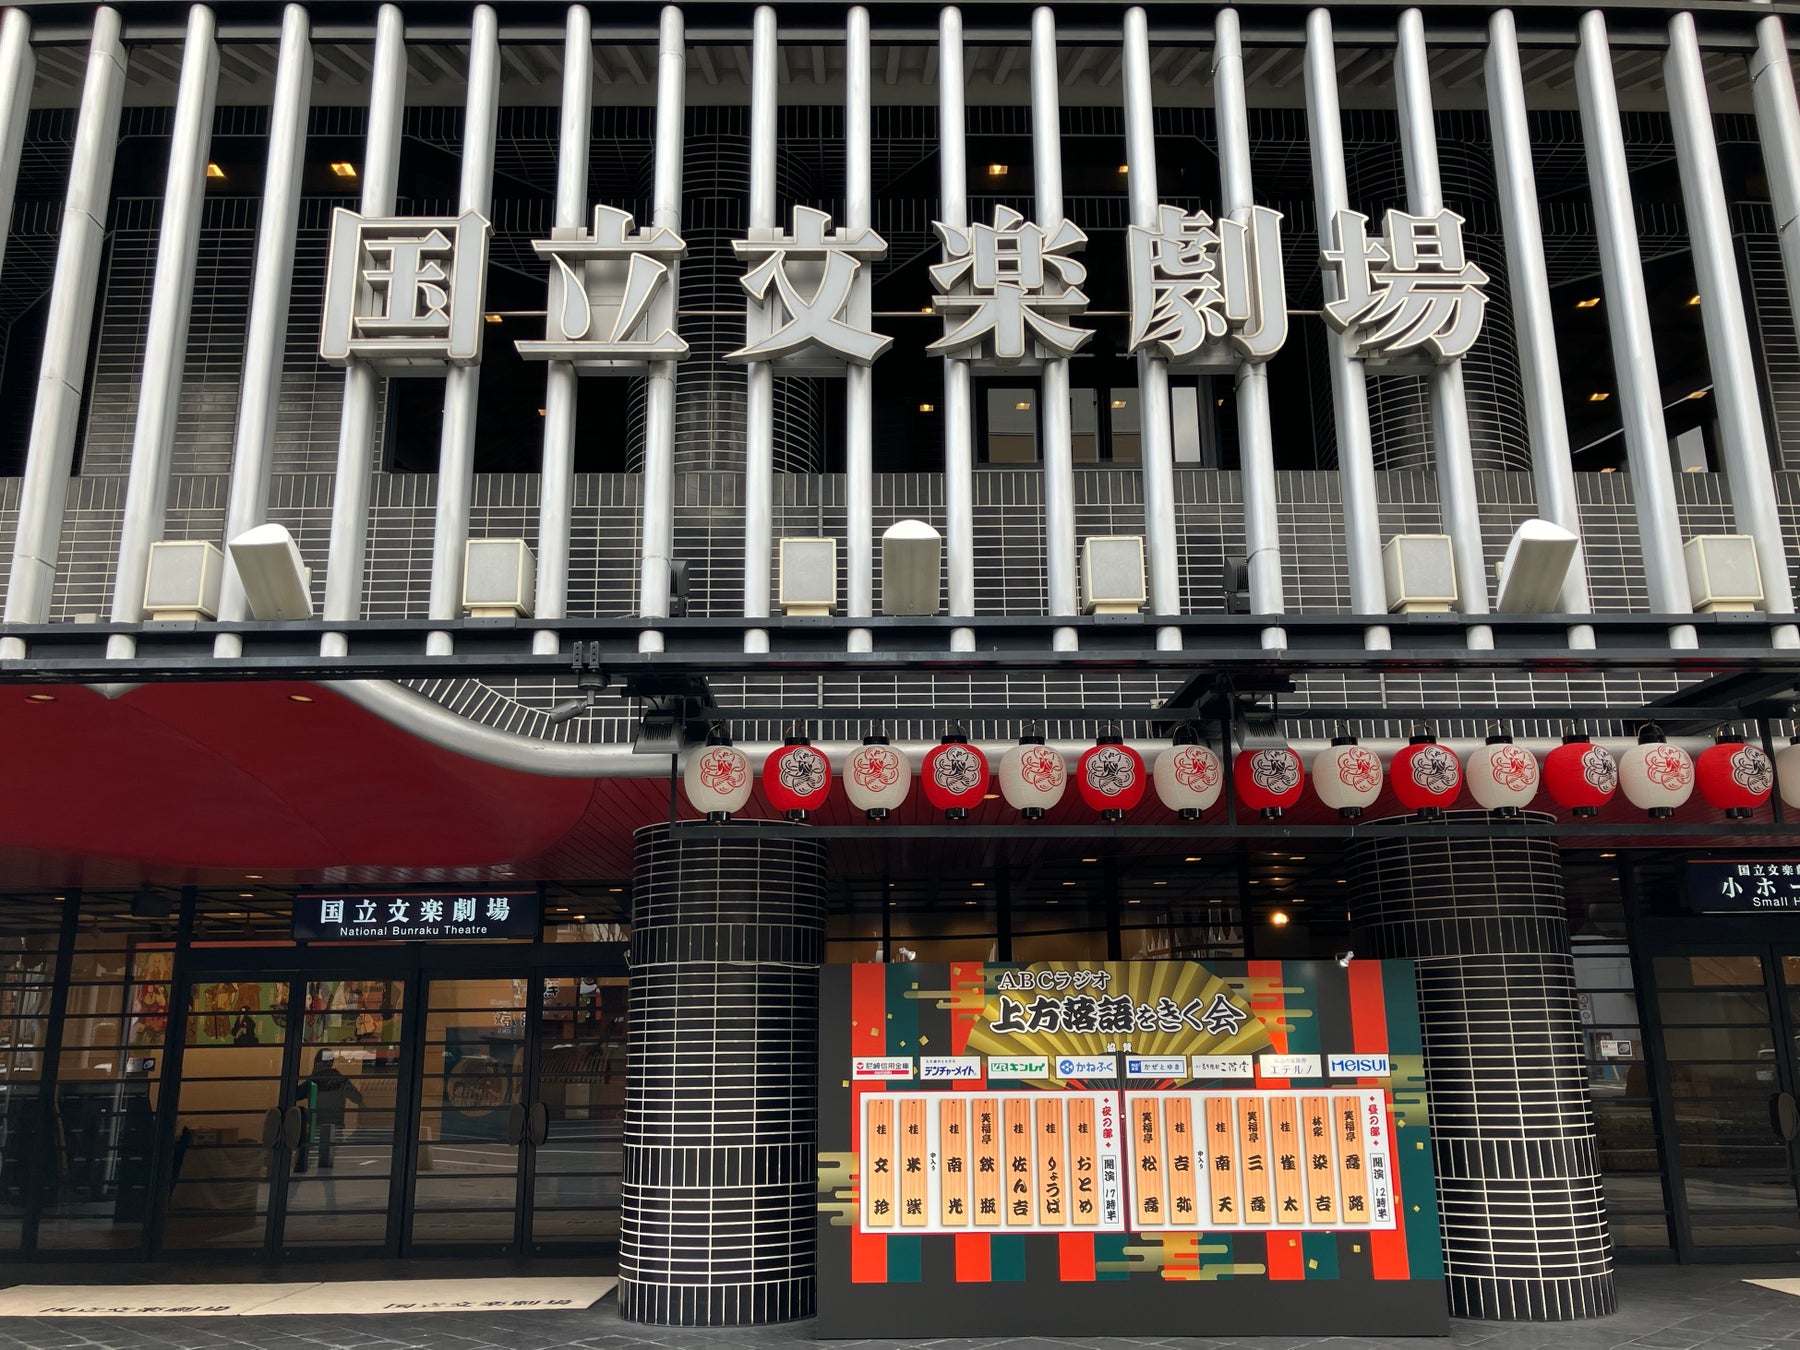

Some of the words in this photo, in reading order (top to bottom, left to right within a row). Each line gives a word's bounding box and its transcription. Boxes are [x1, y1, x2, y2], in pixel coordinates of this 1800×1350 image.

[320, 203, 1490, 366] 国立文楽劇場
[1737, 864, 1800, 876] 国立文楽
[320, 897, 511, 924] 国立文楽劇場
[1752, 897, 1788, 907] Small
[340, 926, 387, 937] National
[392, 925, 439, 936] Bunraku
[444, 925, 488, 935] Theatre
[998, 970, 1111, 990] ABCラジオ
[990, 994, 1247, 1036] 上方落語をきく会
[865, 1062, 909, 1070] 尼崎信用金庫
[924, 1066, 975, 1076] デンチャーメイト
[1009, 1062, 1046, 1073] キンレイ
[1076, 1062, 1113, 1073] かねふく
[1144, 1062, 1181, 1071] かぜとゆき
[1270, 1064, 1312, 1075] エテルノ
[876, 1124, 887, 1135] 桂
[908, 1124, 919, 1135] 桂
[949, 1123, 960, 1134] 桂
[981, 1112, 992, 1145] 笑福亭
[1013, 1123, 1024, 1134] 桂
[1045, 1123, 1056, 1134] 桂
[1078, 1123, 1089, 1134] 桂
[1102, 1106, 1113, 1139] 夜の部
[1142, 1112, 1154, 1143] 笑福亭
[1175, 1122, 1186, 1133] 桂
[1216, 1122, 1226, 1133] 桂
[1247, 1111, 1259, 1143] 笑福亭
[1280, 1121, 1291, 1132] 桂
[1312, 1116, 1323, 1137] 林家
[1344, 1110, 1356, 1142] 笑福亭
[1368, 1104, 1380, 1137] 昼の部
[874, 1157, 890, 1215] 文珍
[947, 1156, 963, 1214] 南光
[1012, 1156, 1029, 1216] 佐ん吉
[1077, 1156, 1093, 1214] おとめ
[1174, 1155, 1193, 1213] 吉弥
[1215, 1155, 1233, 1213] 南天
[1280, 1154, 1299, 1212] 雀太
[1312, 1154, 1331, 1212] 染吉
